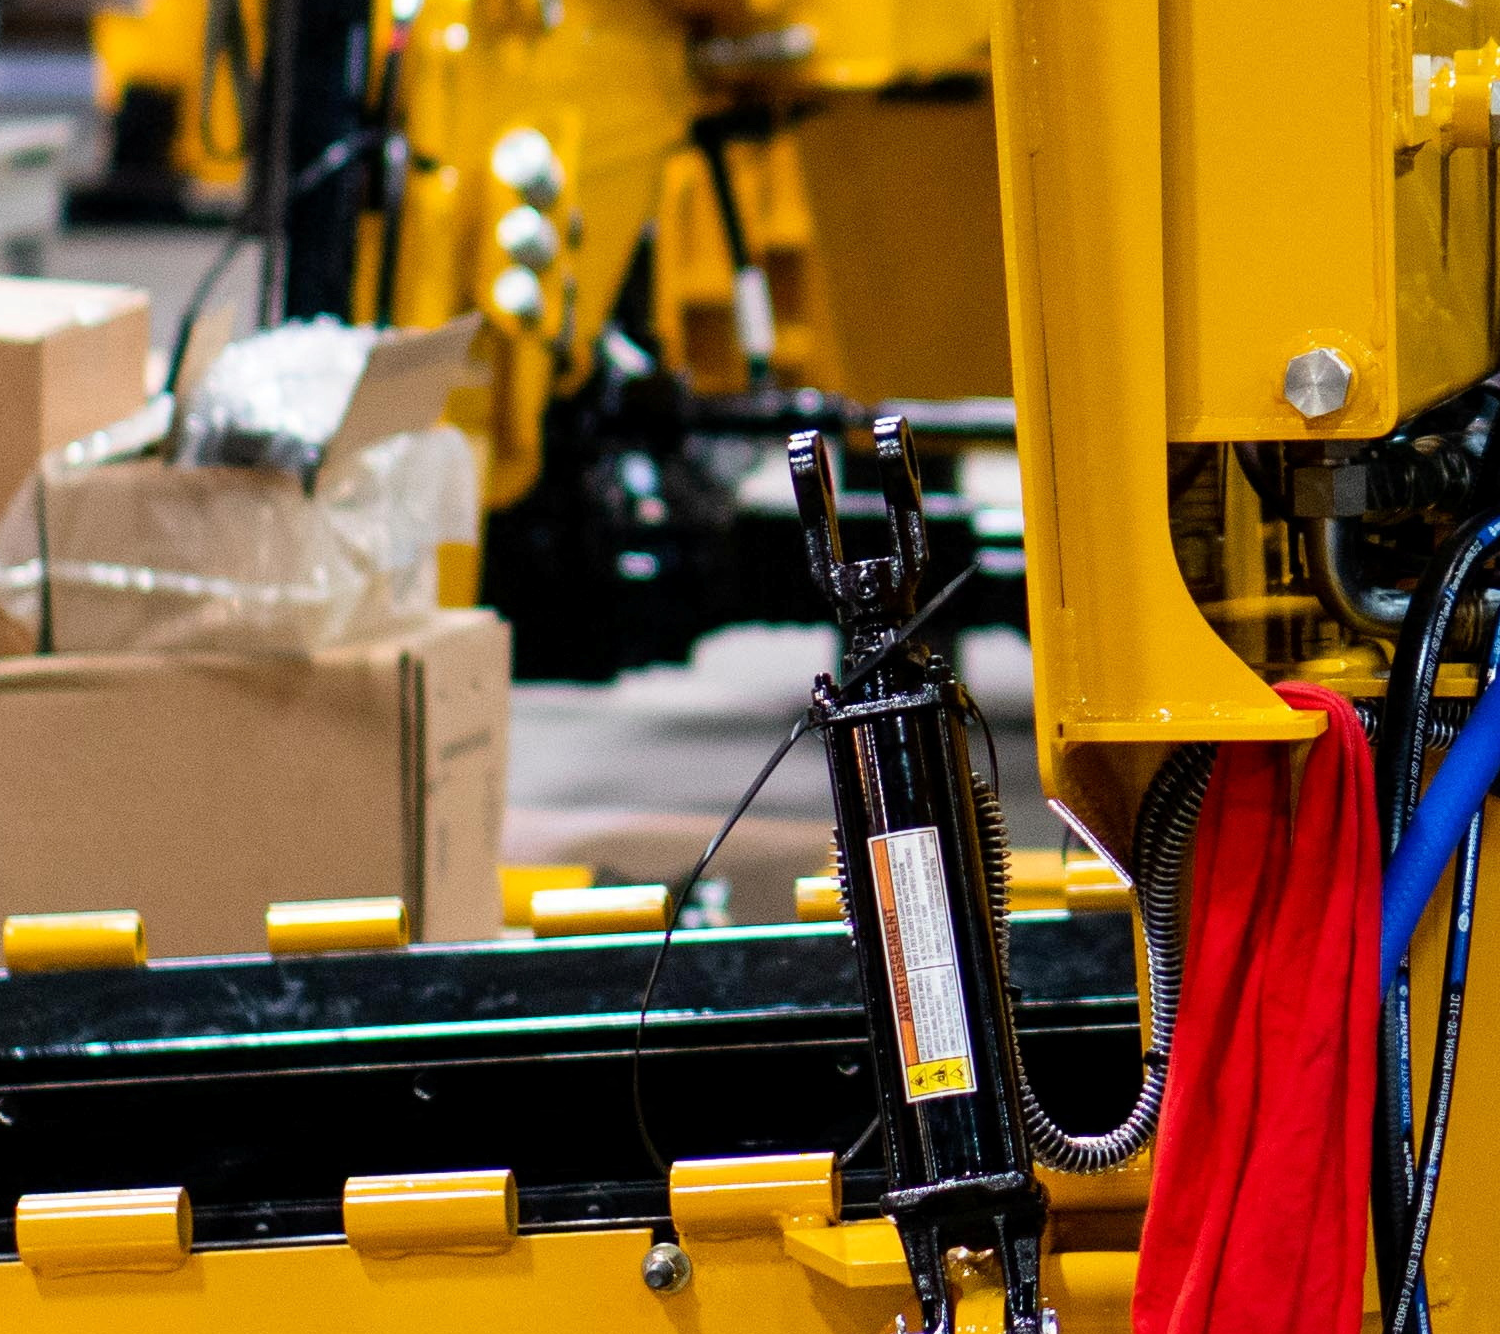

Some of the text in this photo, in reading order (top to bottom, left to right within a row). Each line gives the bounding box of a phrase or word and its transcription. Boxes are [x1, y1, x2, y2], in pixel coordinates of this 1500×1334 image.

[1419, 685, 1431, 703] SAE
[1415, 709, 1428, 730] R17
[1410, 728, 1425, 759] 11237
[1408, 760, 1421, 778] ISO
[1440, 1037, 1458, 1070] MSHA
[1432, 1071, 1455, 1125] Resistant
[1408, 1219, 1427, 1257] 18752
[1404, 1258, 1419, 1279] ISO
[1392, 1288, 1412, 1333] 100R17
